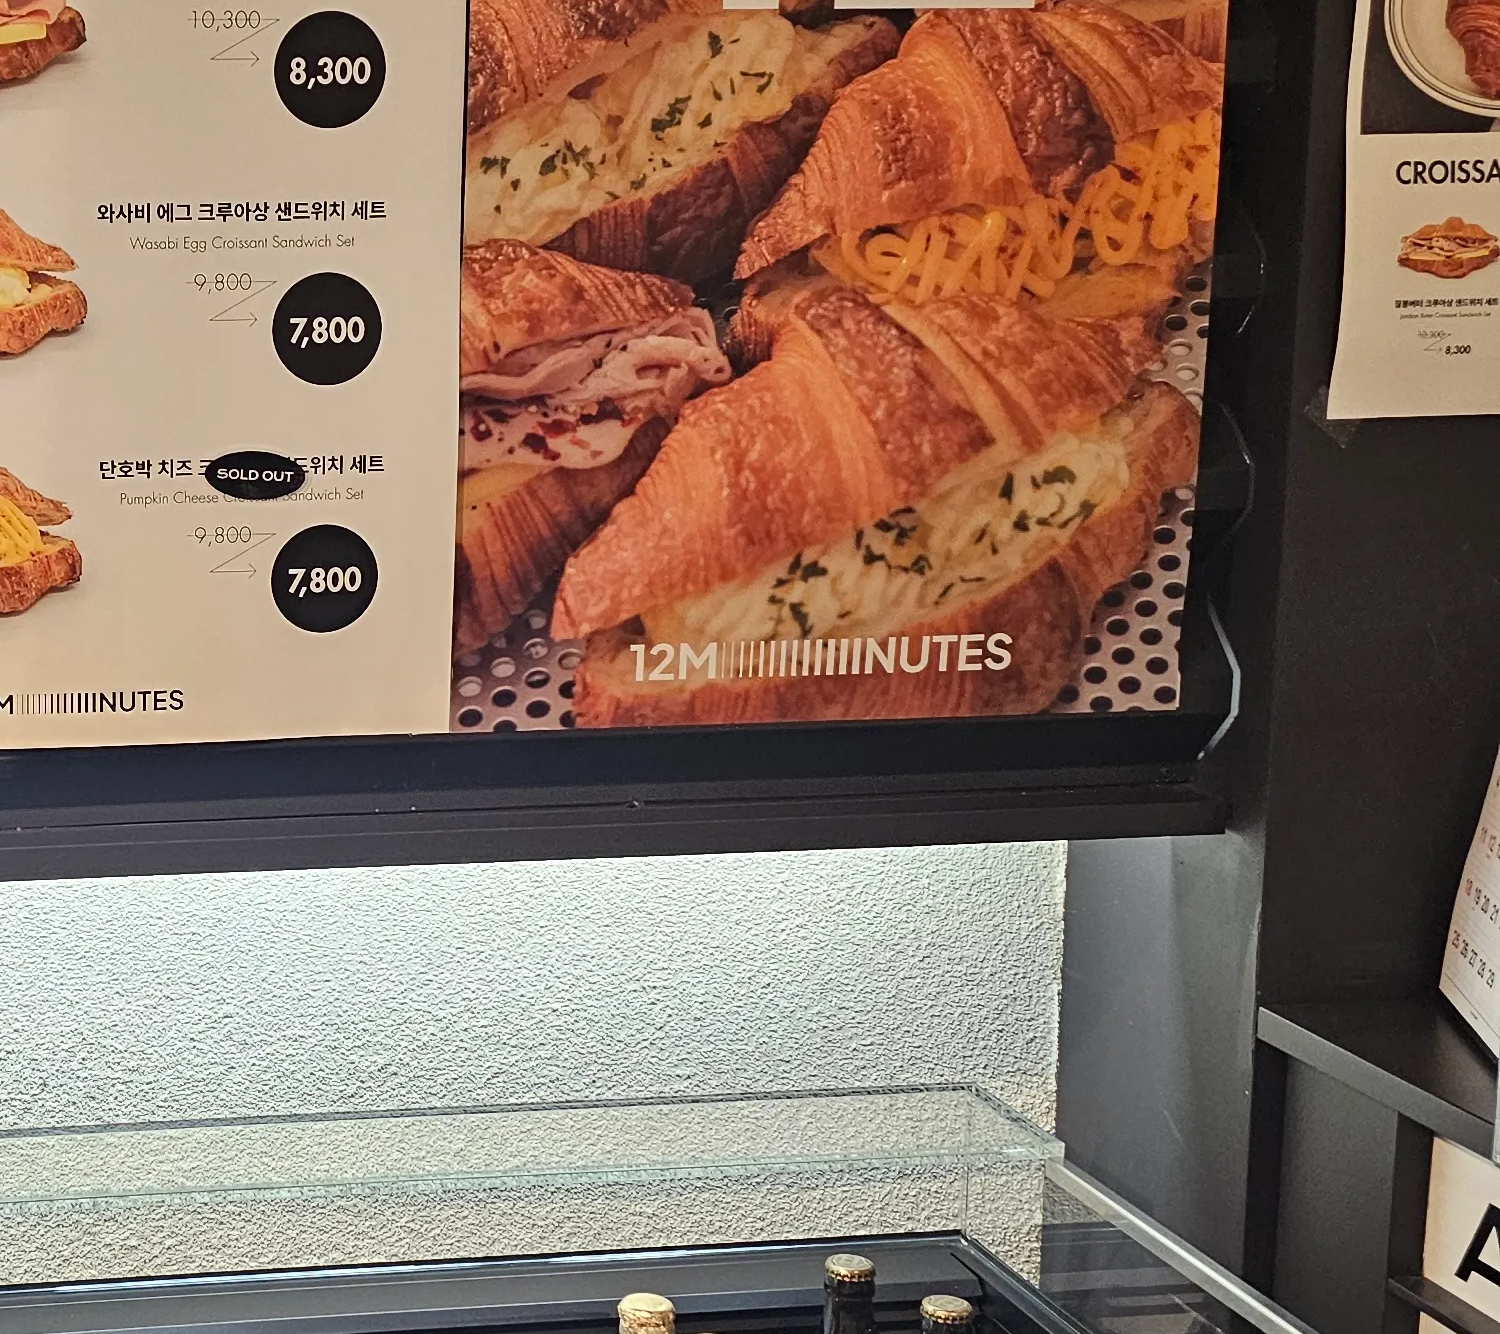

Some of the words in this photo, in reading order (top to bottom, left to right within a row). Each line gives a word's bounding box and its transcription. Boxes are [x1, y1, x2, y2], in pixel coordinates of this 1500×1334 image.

[190, 10, 261, 32] 10,300
[289, 56, 372, 90] 8,300
[97, 202, 151, 223] 와사비
[156, 202, 192, 224] 에그
[198, 201, 269, 222] 크루아상
[274, 200, 345, 222] 샌드위치
[351, 200, 387, 220] 세트
[129, 236, 179, 250] Wasabi
[183, 236, 207, 252] Egg
[212, 235, 268, 249] Croissant
[272, 234, 332, 248] Sandwich
[336, 234, 355, 247] Set
[194, 272, 252, 294] 9,800
[288, 316, 365, 348] 7,800
[1445, 344, 1471, 357] 8,300
[99, 458, 152, 479] 단호박
[157, 459, 193, 478] 치즈
[290, 455, 344, 475] 드위치
[349, 454, 385, 473] 세트
[217, 468, 259, 481] SOLD
[262, 470, 294, 483] OUT
[120, 491, 169, 508] Pumpkin
[173, 491, 219, 504] Cheese
[282, 487, 341, 502] Sandwich
[345, 487, 364, 500] Set
[194, 525, 252, 547] 9,800
[288, 566, 362, 598] 7,800
[1481, 895, 1490, 914] 20
[1490, 904, 1499, 923] 21
[1468, 948, 1478, 968] 27
